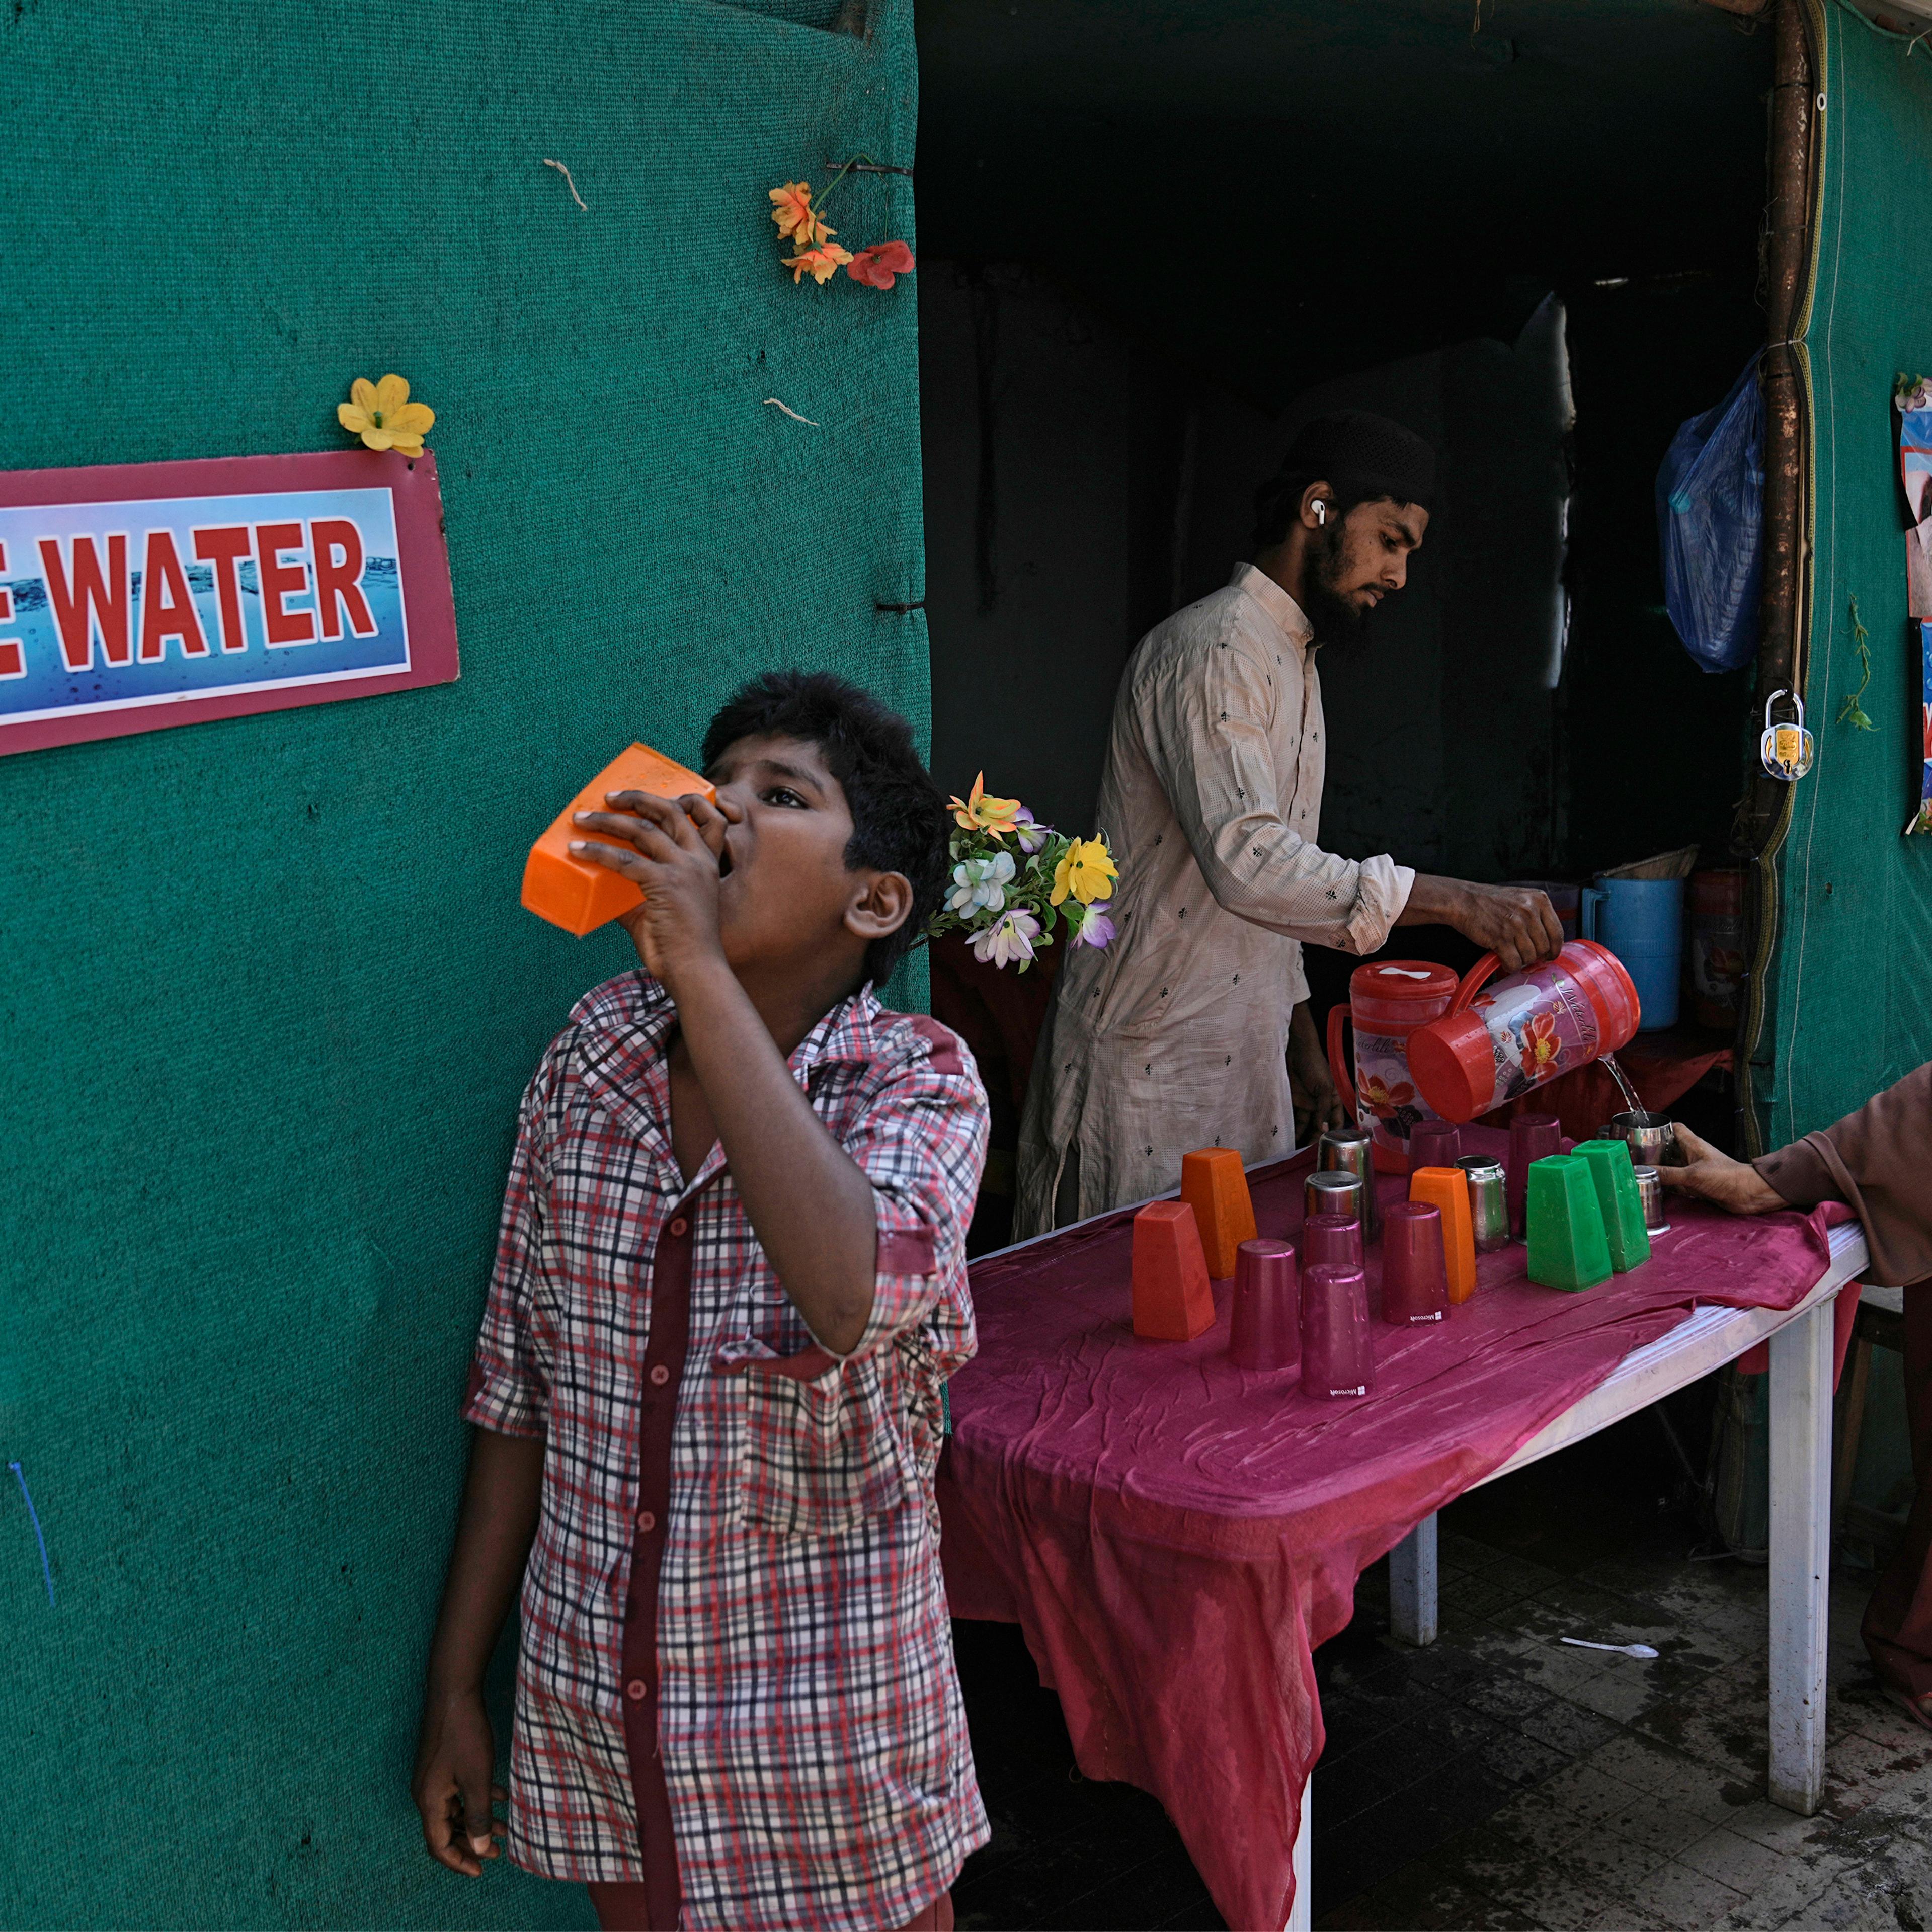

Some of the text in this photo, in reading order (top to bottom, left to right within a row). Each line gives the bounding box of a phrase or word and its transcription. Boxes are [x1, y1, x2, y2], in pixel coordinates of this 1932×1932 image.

[37, 519, 378, 668] WATER
[1356, 1035, 1392, 1053] aterlili
[1410, 1314, 1435, 1322] Microsoft
